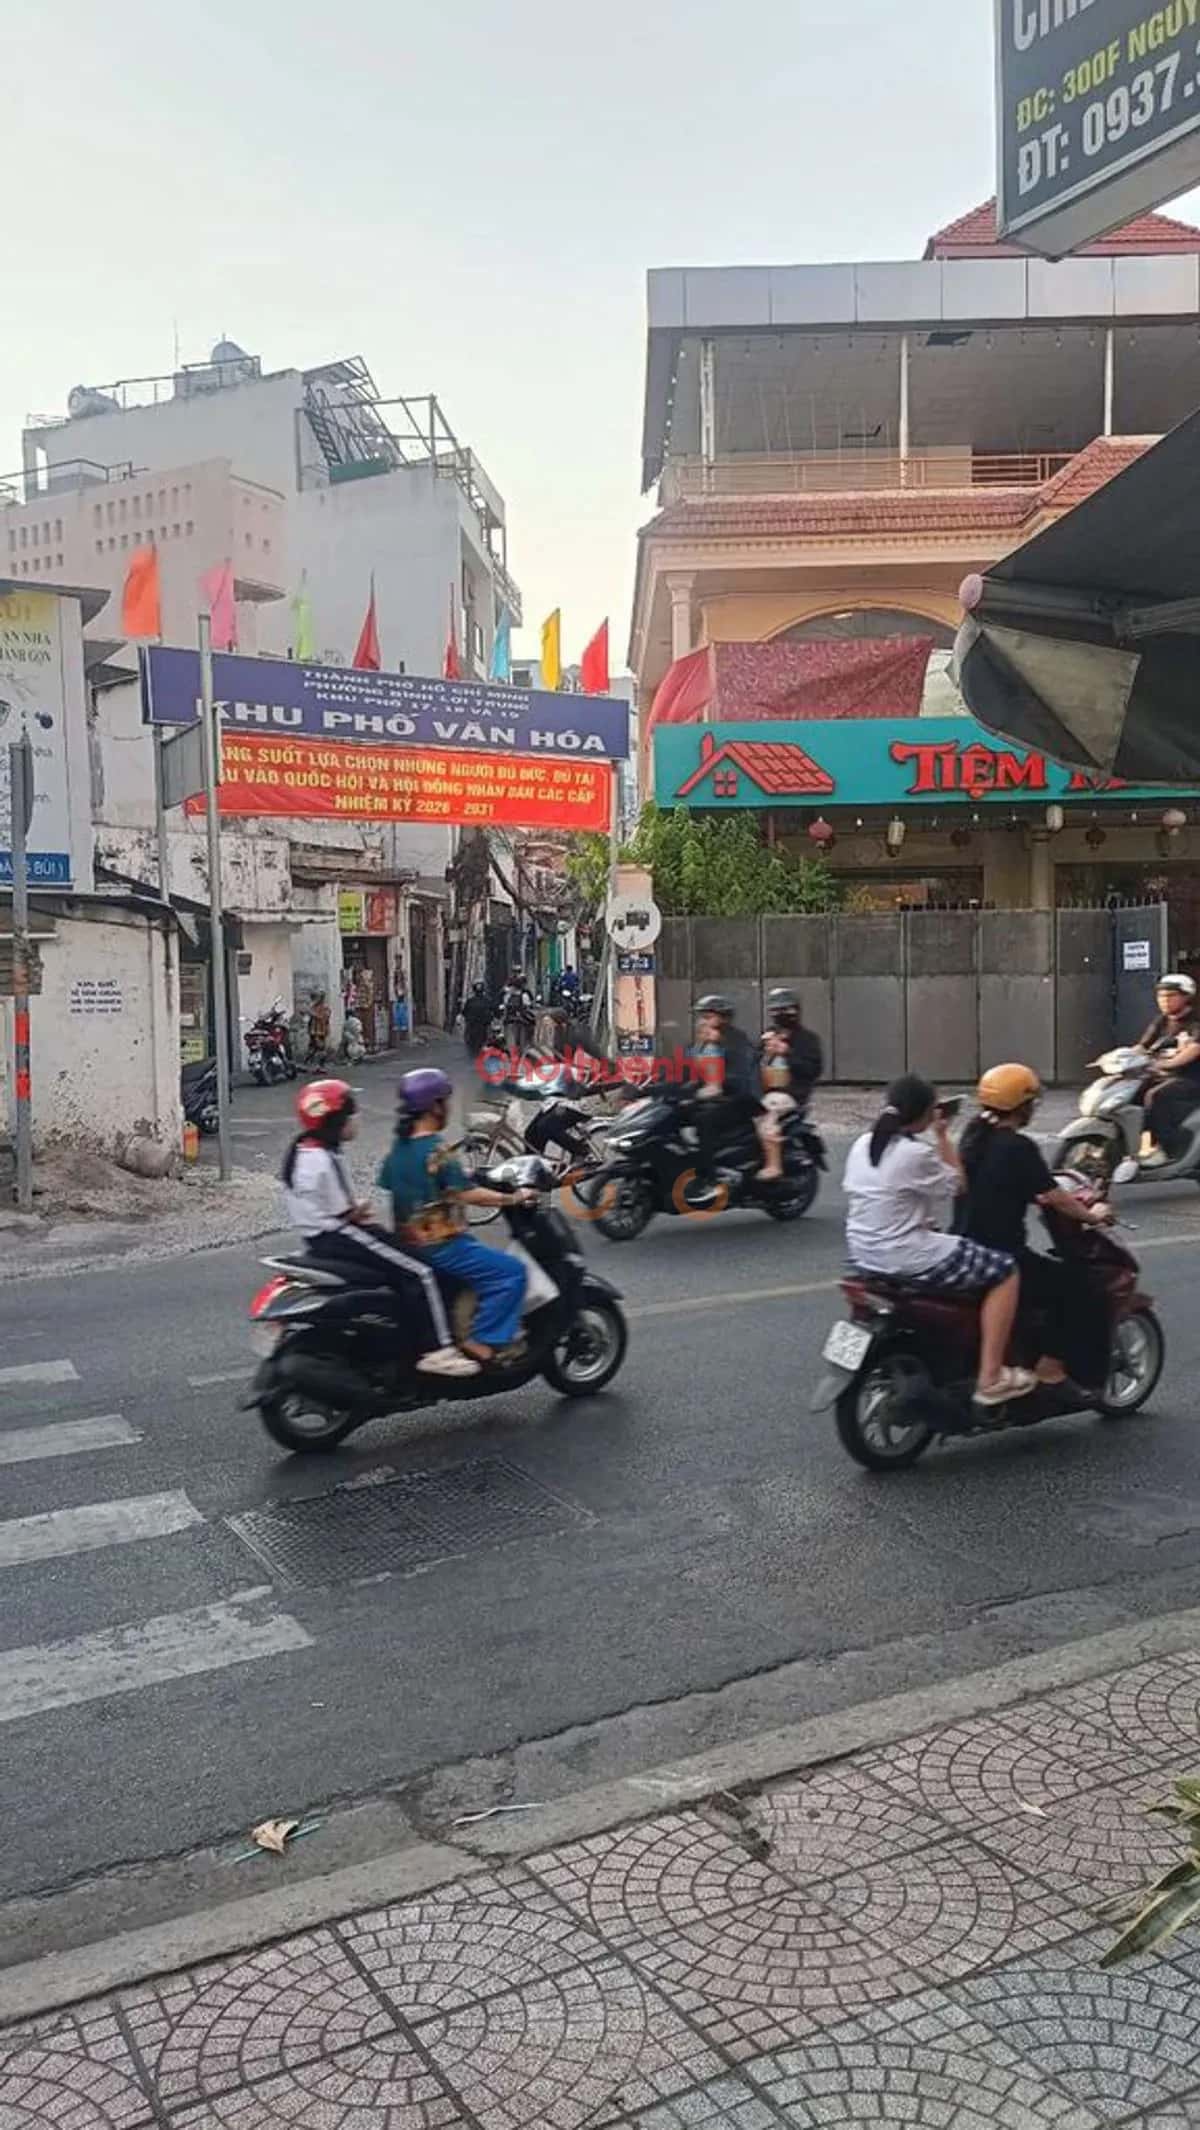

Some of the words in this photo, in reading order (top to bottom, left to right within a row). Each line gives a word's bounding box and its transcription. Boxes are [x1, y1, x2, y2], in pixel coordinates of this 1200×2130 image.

[1063, 39, 1120, 103] 300F
[1018, 123, 1069, 196] ĐT:
[1082, 40, 1200, 156] 0937.
[196, 699, 303, 725] KHU
[323, 711, 421, 736] PHỐ
[432, 717, 517, 745] VĂN
[530, 726, 607, 751] HÓA
[258, 745, 305, 765] SUỐT
[284, 768, 330, 788] QUỐC
[890, 740, 1048, 799] TIỆM
